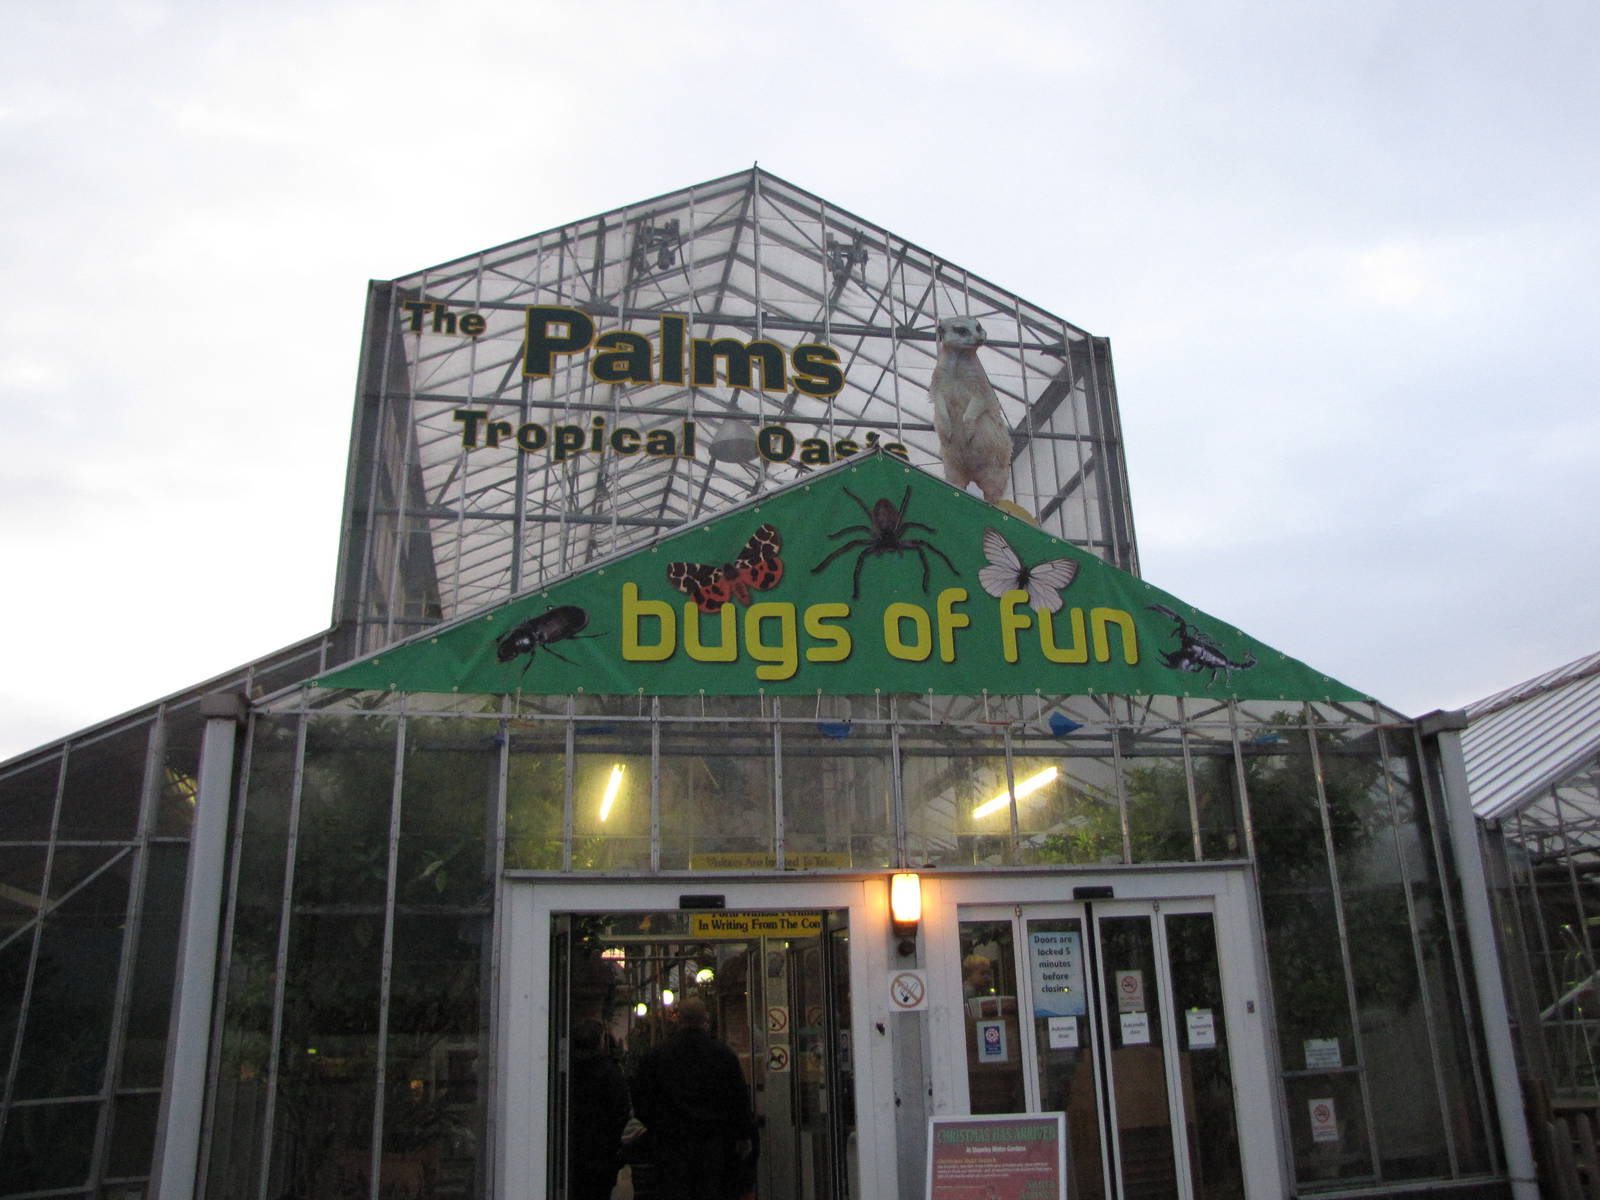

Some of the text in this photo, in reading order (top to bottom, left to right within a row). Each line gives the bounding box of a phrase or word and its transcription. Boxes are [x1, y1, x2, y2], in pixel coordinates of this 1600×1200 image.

[403, 301, 845, 398] The Palms
[453, 409, 696, 462] Tropical
[621, 581, 1138, 680] bugs of fun
[698, 919, 709, 930] In
[711, 919, 749, 932] Writing
[752, 918, 777, 930] From
[780, 918, 798, 929] The
[1034, 935, 1057, 944] Doors
[1037, 947, 1063, 956] locked
[1039, 959, 1071, 968] minutes
[1043, 972, 1068, 980] before
